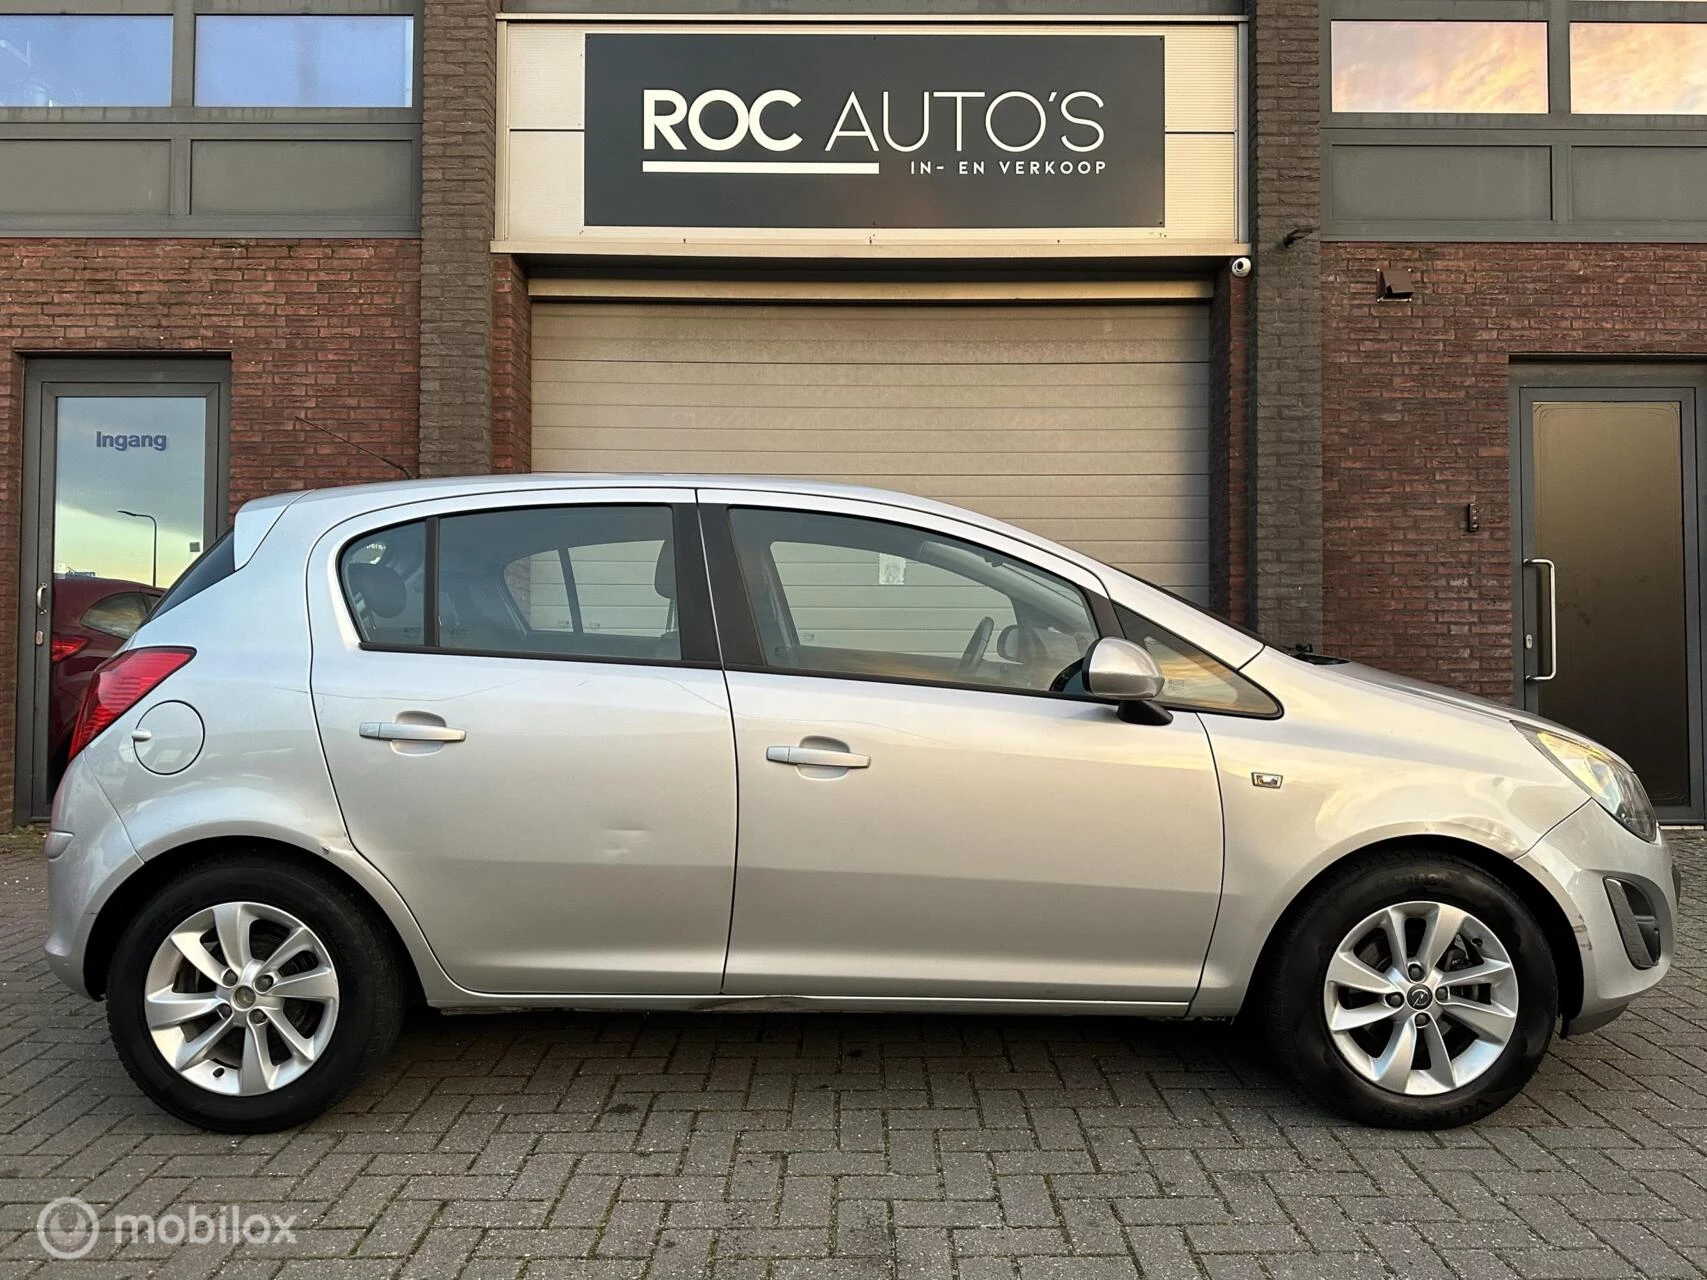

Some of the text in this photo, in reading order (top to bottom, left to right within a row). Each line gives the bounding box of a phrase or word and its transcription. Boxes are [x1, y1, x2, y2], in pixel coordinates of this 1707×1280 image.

[643, 89, 1105, 153] ROC AUTO'S
[910, 160, 1106, 175] IN- EN VERKOOP
[96, 431, 167, 451] Ingang
